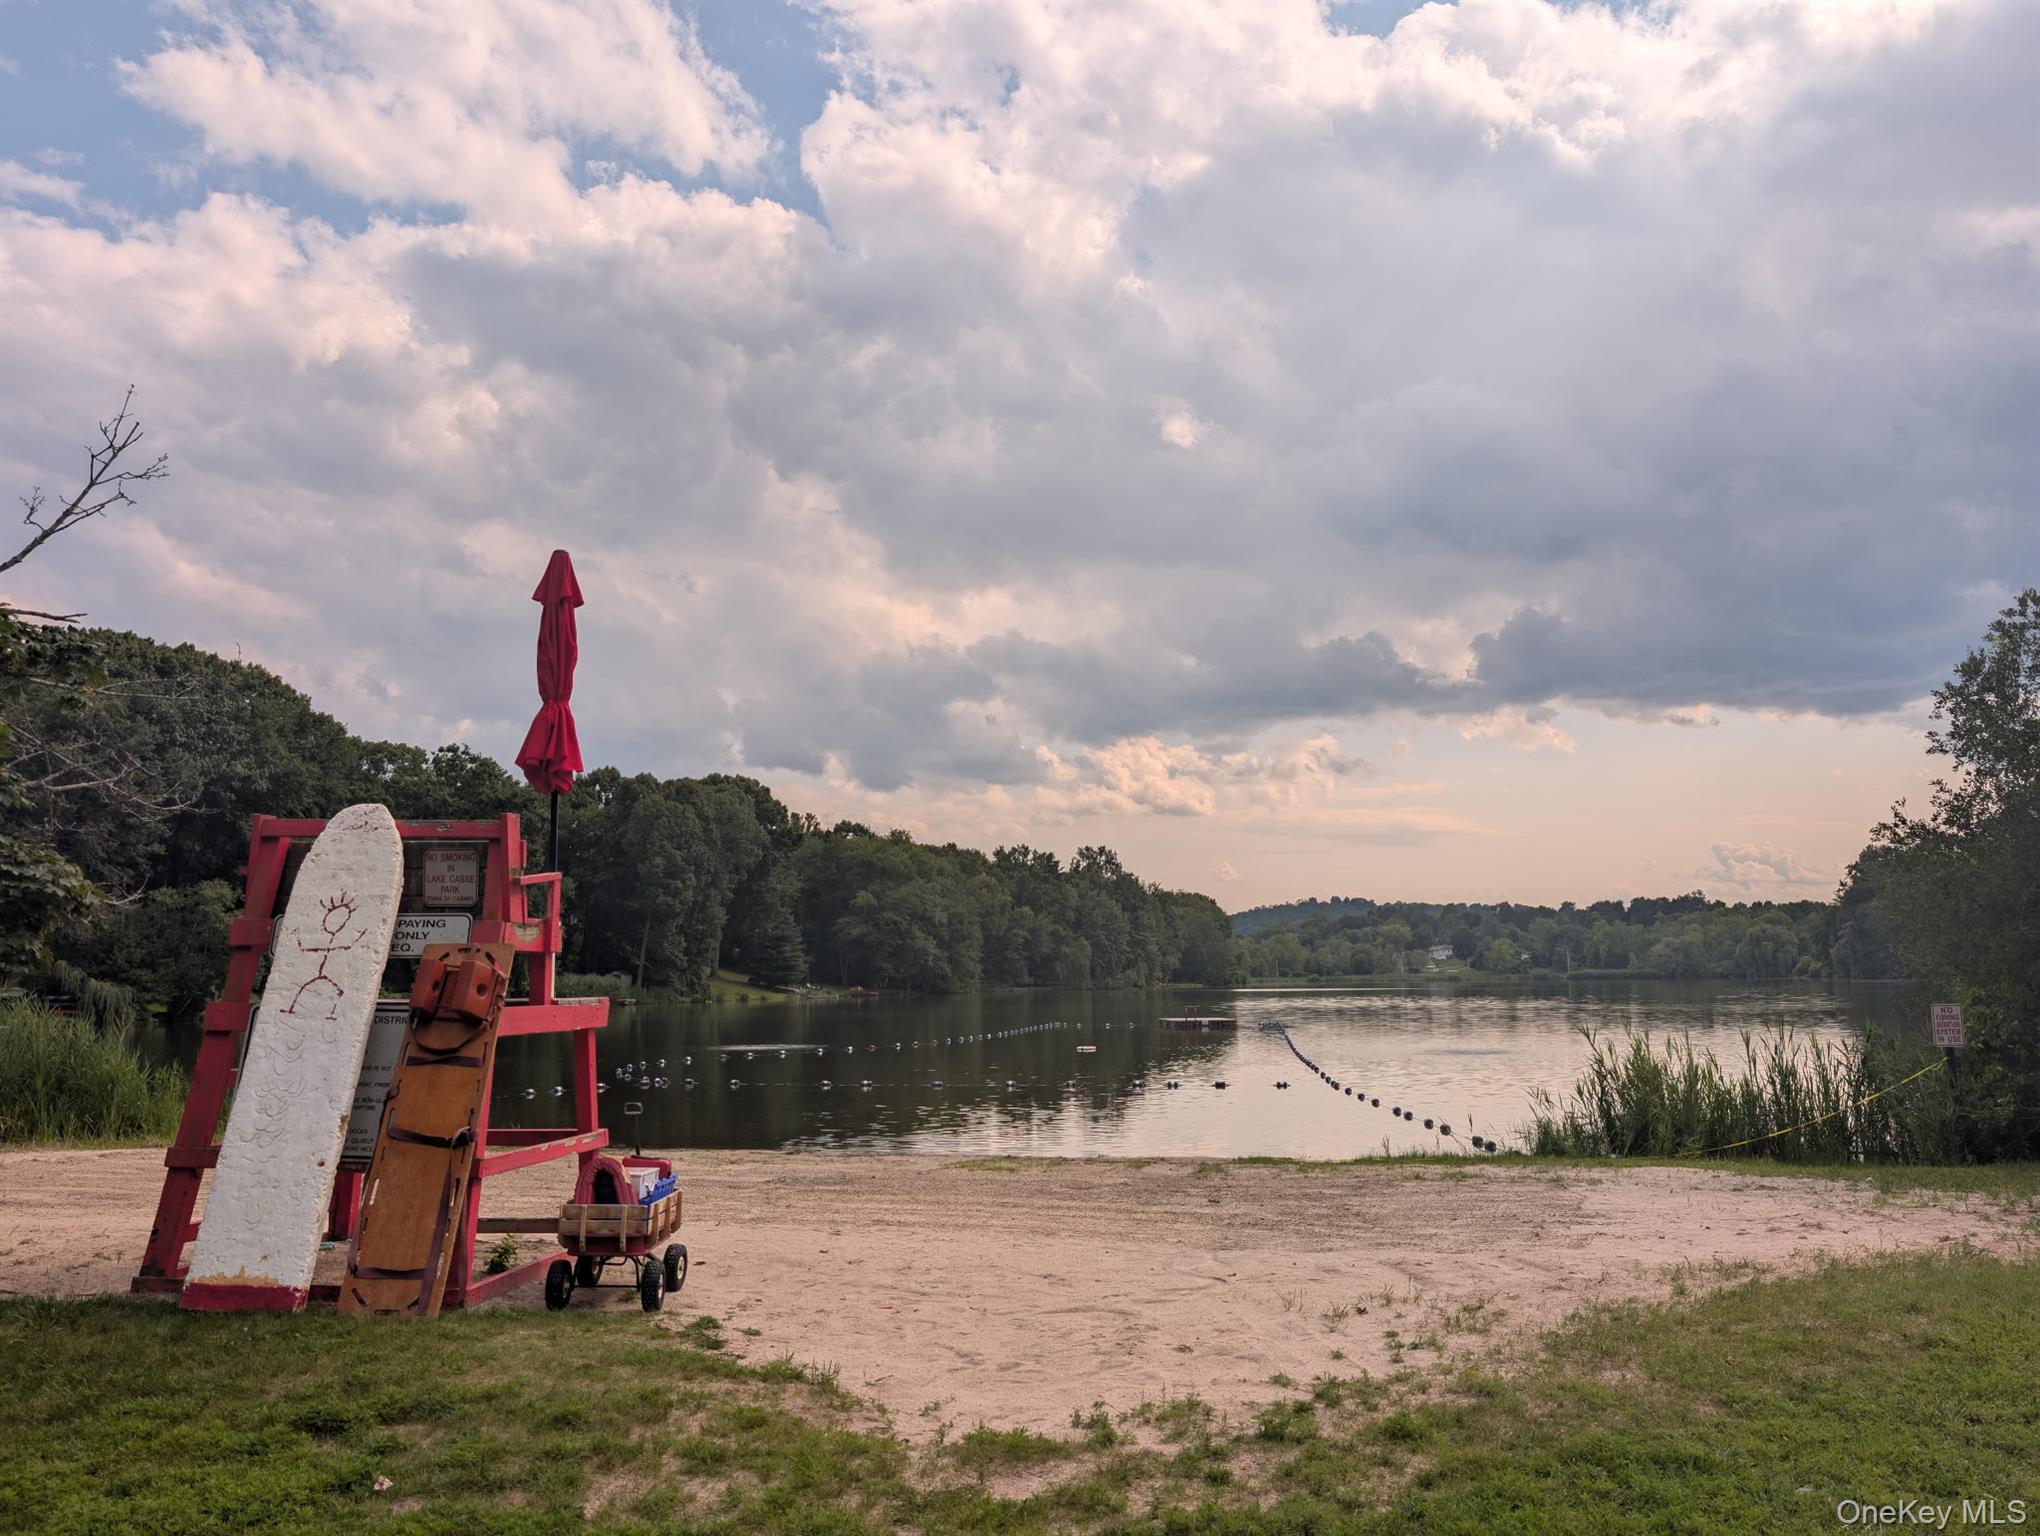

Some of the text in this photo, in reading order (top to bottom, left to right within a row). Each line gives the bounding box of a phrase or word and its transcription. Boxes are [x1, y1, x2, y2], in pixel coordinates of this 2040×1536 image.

[427, 852, 476, 862] NO SMOKING
[447, 864, 455, 872] IN
[427, 874, 475, 883] LAKE CASSE
[440, 885, 460, 894] PARK
[398, 920, 447, 928] PAYING
[395, 931, 430, 940] ONLY
[391, 943, 415, 952] EQ.
